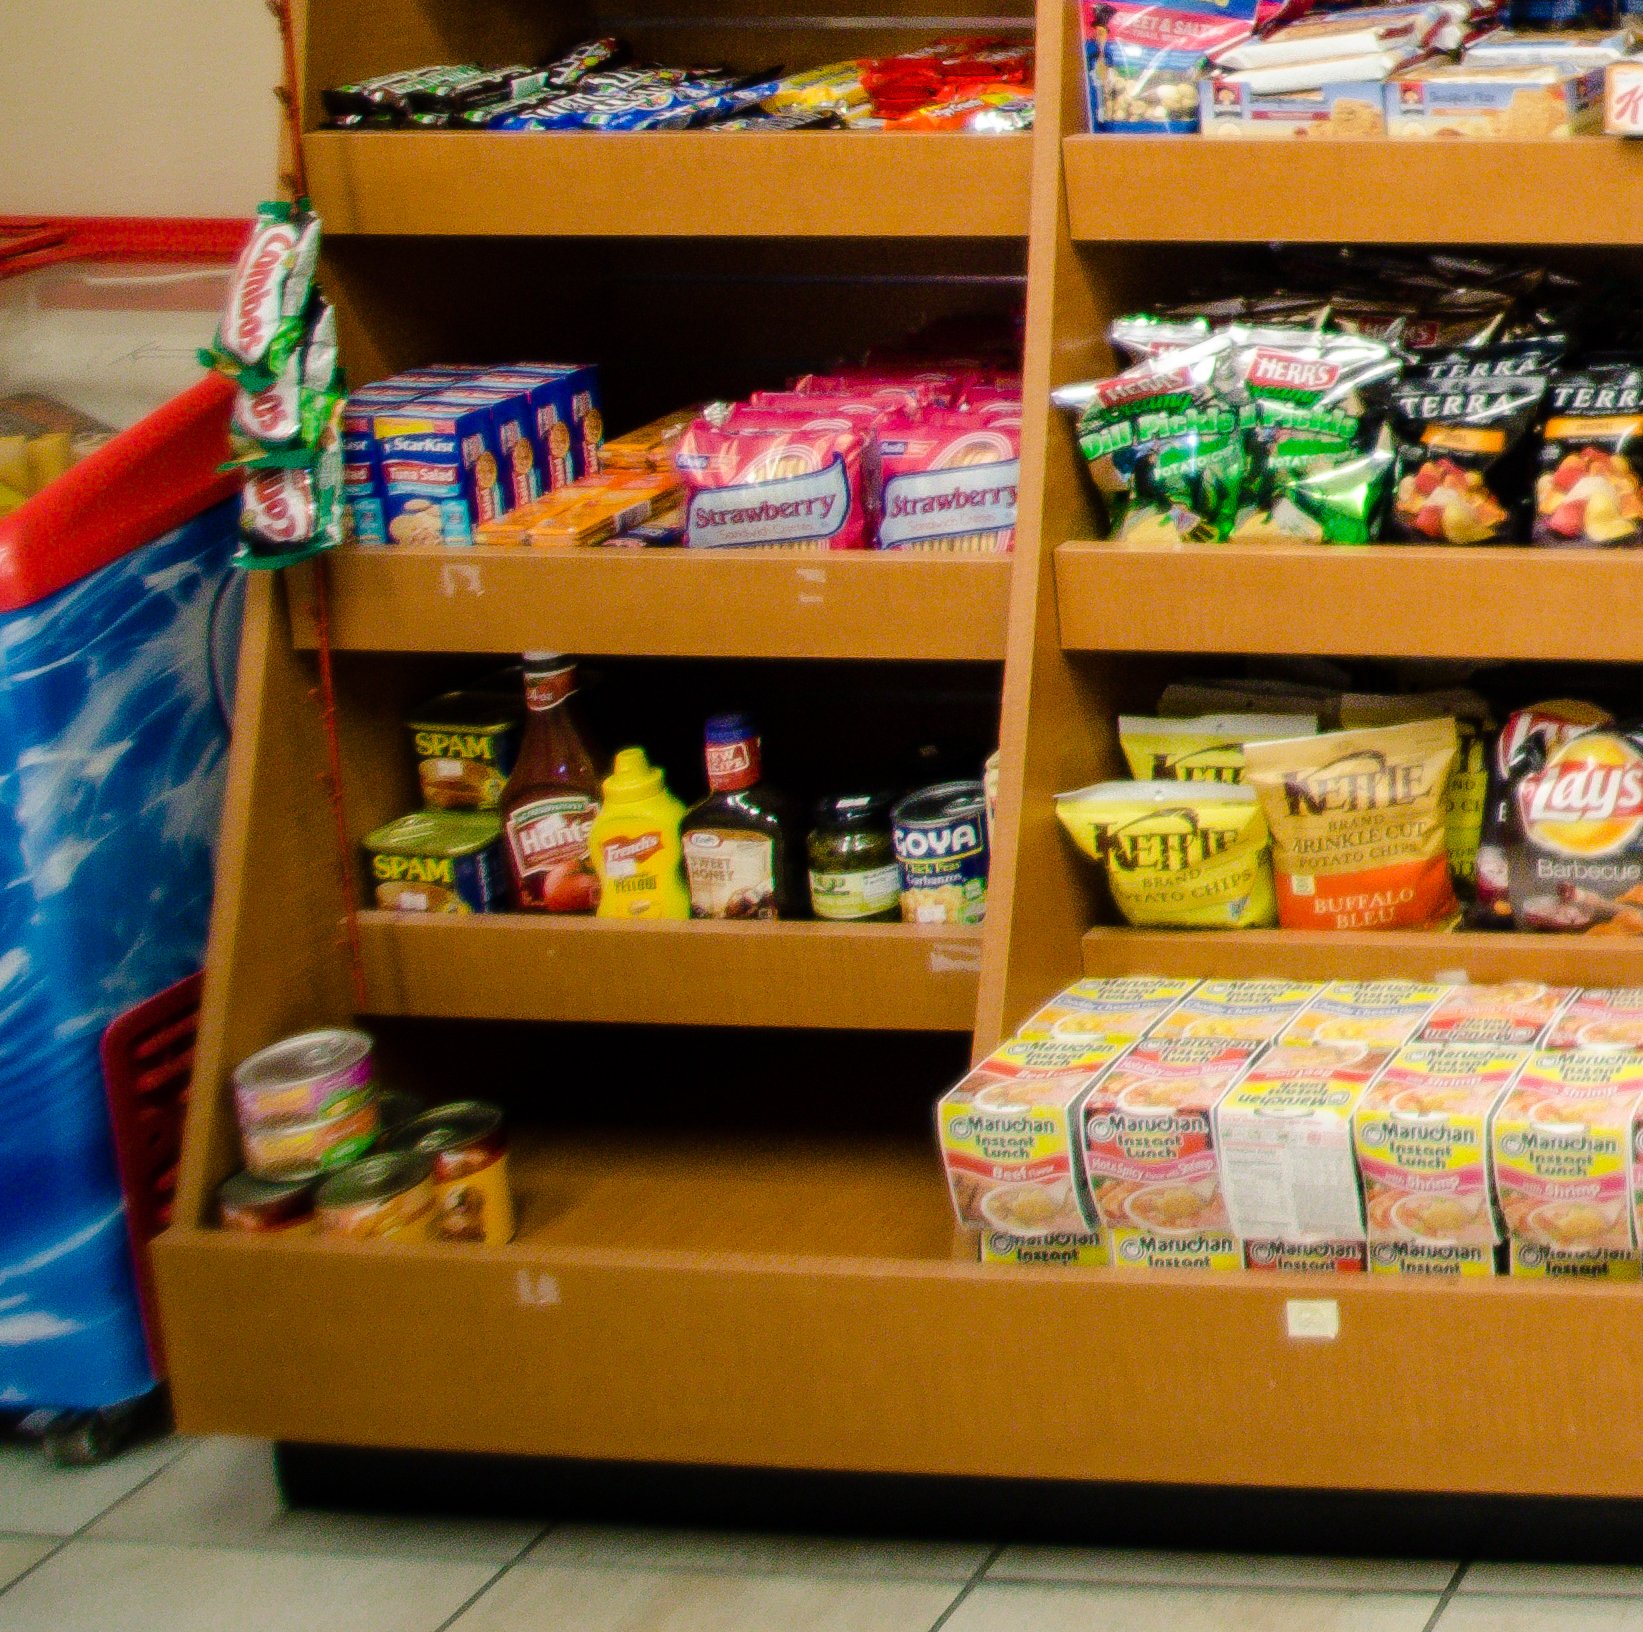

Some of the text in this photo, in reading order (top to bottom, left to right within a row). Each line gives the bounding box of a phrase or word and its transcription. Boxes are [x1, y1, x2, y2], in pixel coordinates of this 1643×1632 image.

[694, 491, 838, 529] Strawberry
[889, 483, 1019, 519] Strawberry
[414, 731, 495, 761] SPAM
[894, 824, 978, 857] GOYA
[372, 854, 454, 883] SPAM
[1536, 859, 1643, 882] Barbecue
[1312, 887, 1417, 915] BUFFALO
[1335, 907, 1396, 930] BLEU
[967, 1116, 1056, 1136] Maruchan
[1109, 1115, 1206, 1134] Maruchan
[1382, 1123, 1477, 1144] Maruchan
[975, 1135, 1036, 1149] Instant
[982, 1147, 1031, 1160] Lunch
[1521, 1132, 1618, 1152] Maruchan
[1138, 1236, 1234, 1254] Maruchan
